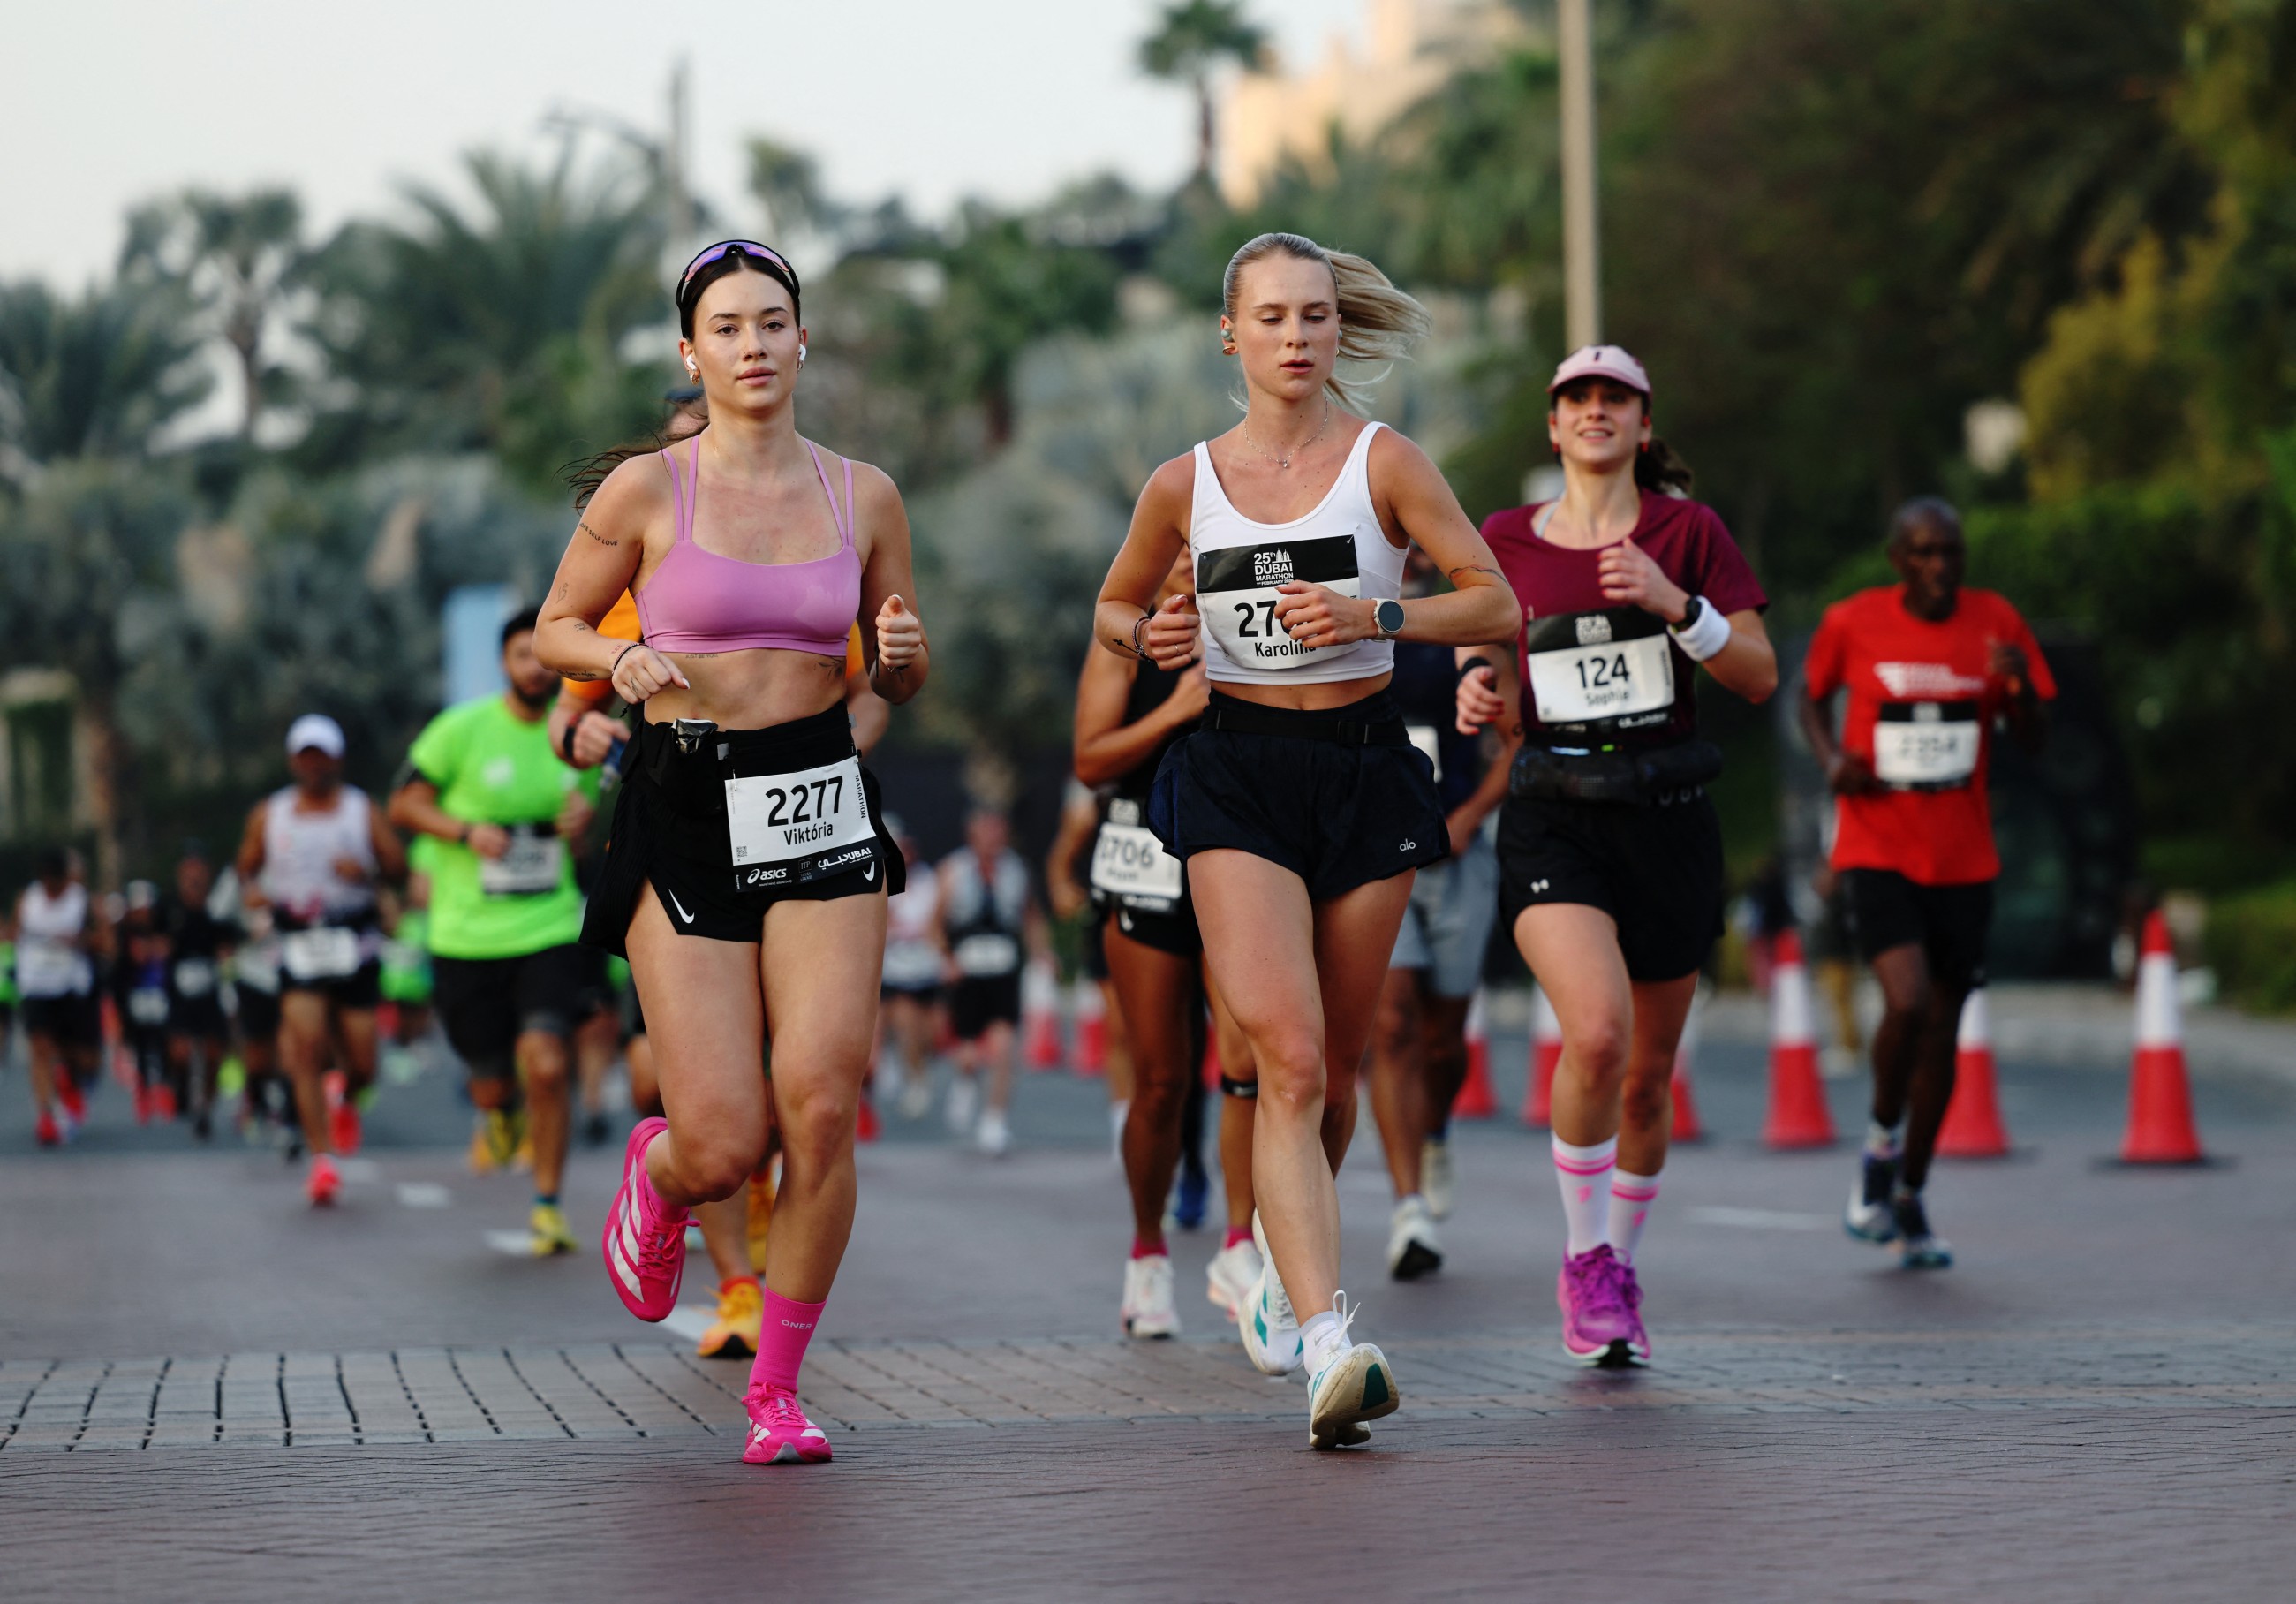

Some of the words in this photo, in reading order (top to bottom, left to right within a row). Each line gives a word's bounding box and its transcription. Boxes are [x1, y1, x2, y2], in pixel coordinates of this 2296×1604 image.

[589, 529, 601, 541] SELF
[1254, 552, 1276, 565] 25th
[1255, 563, 1293, 575] DUBAI
[1255, 572, 1294, 582] MARATHON
[1576, 653, 1630, 689] 124
[765, 775, 843, 828] 2277
[854, 775, 866, 819] MARATHON
[783, 822, 834, 846] Viktória
[1399, 838, 1416, 851] alo
[759, 868, 788, 881] asics
